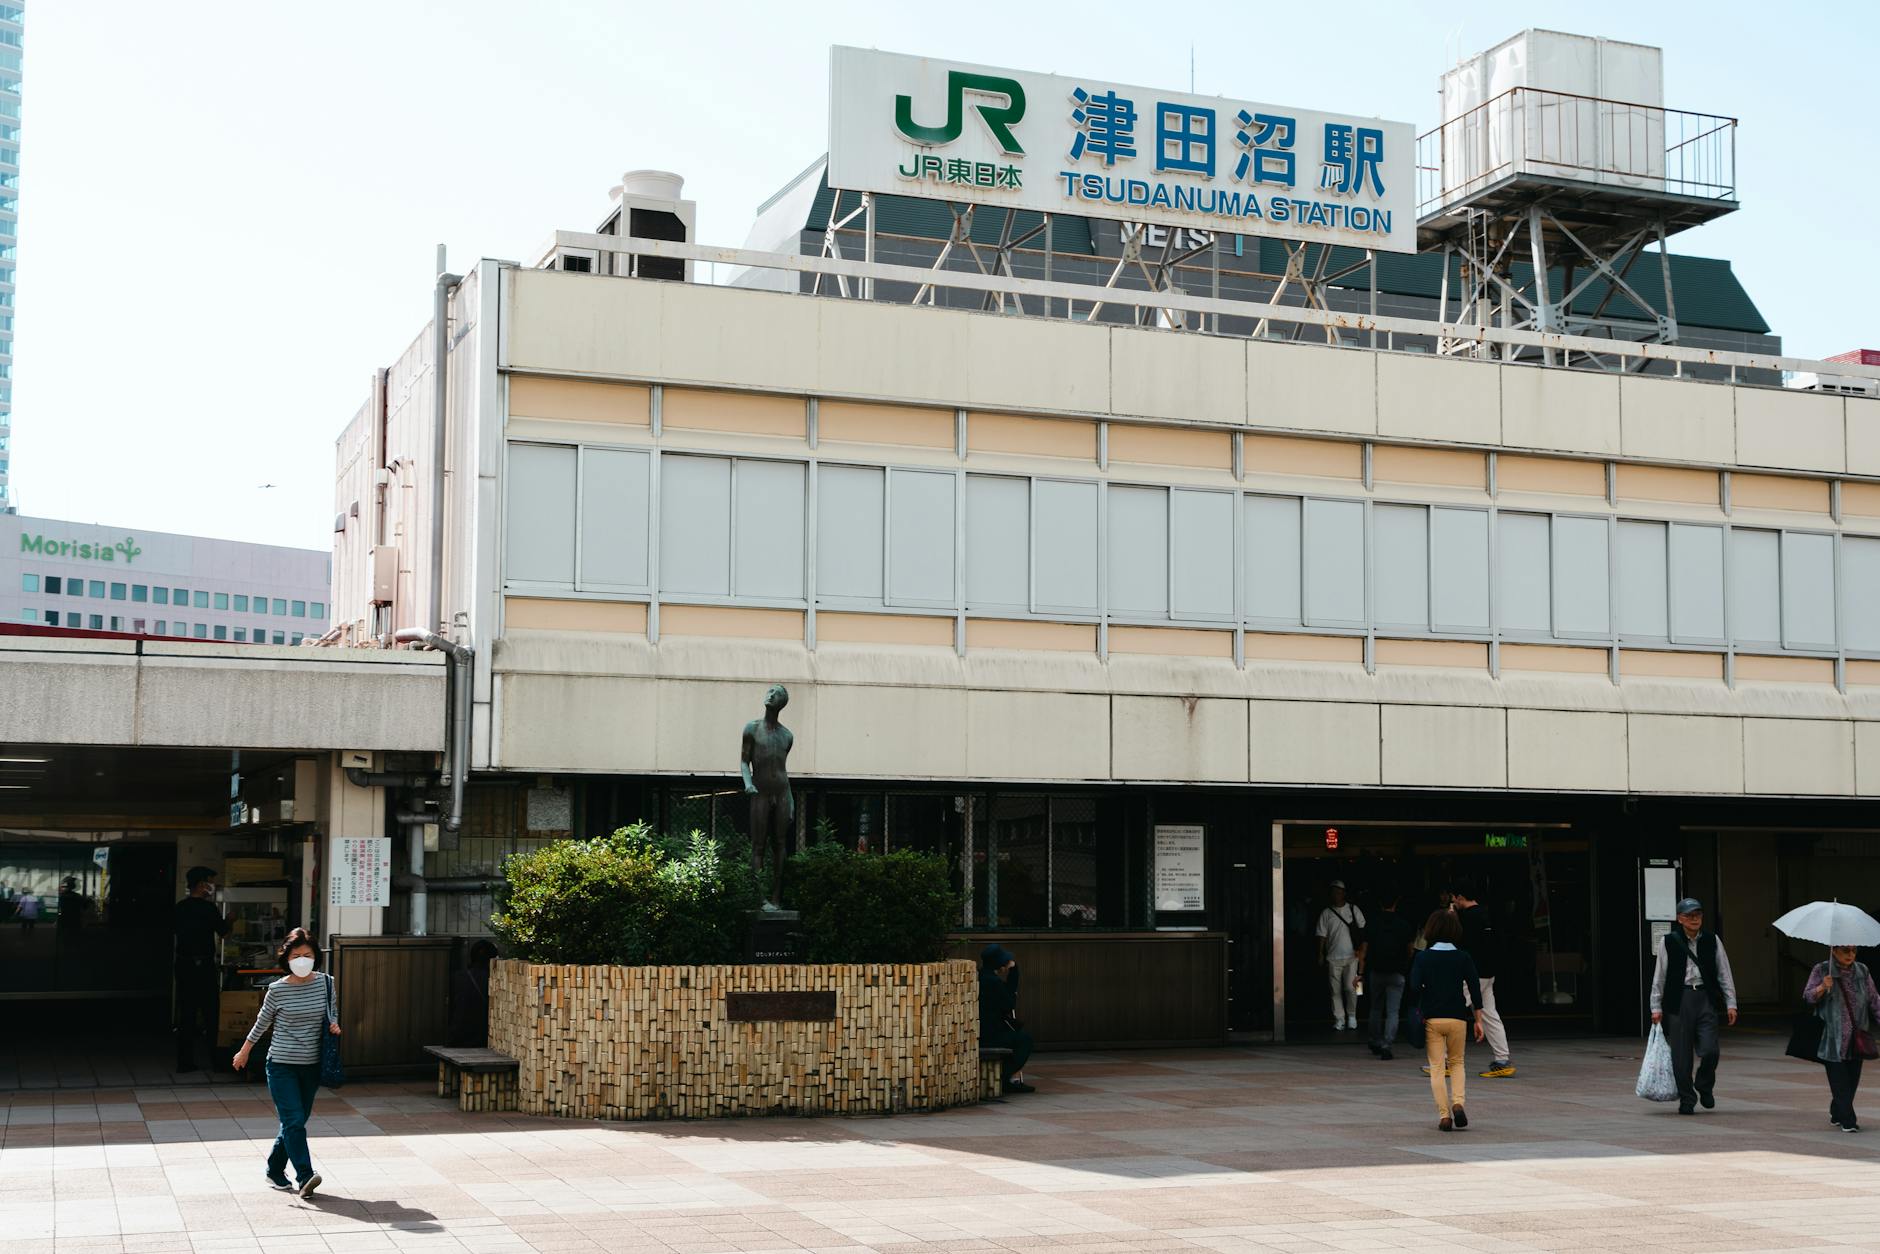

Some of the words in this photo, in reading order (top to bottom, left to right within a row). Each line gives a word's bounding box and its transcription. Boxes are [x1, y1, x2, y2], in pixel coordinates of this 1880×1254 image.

[896, 71, 1026, 153] JR
[1070, 87, 1385, 198] 津田沼駅
[899, 154, 1022, 189] JR東日本
[1060, 171, 1263, 218] TSUDANUMA
[1270, 196, 1392, 233] STATION
[21, 533, 114, 561] Morisia
